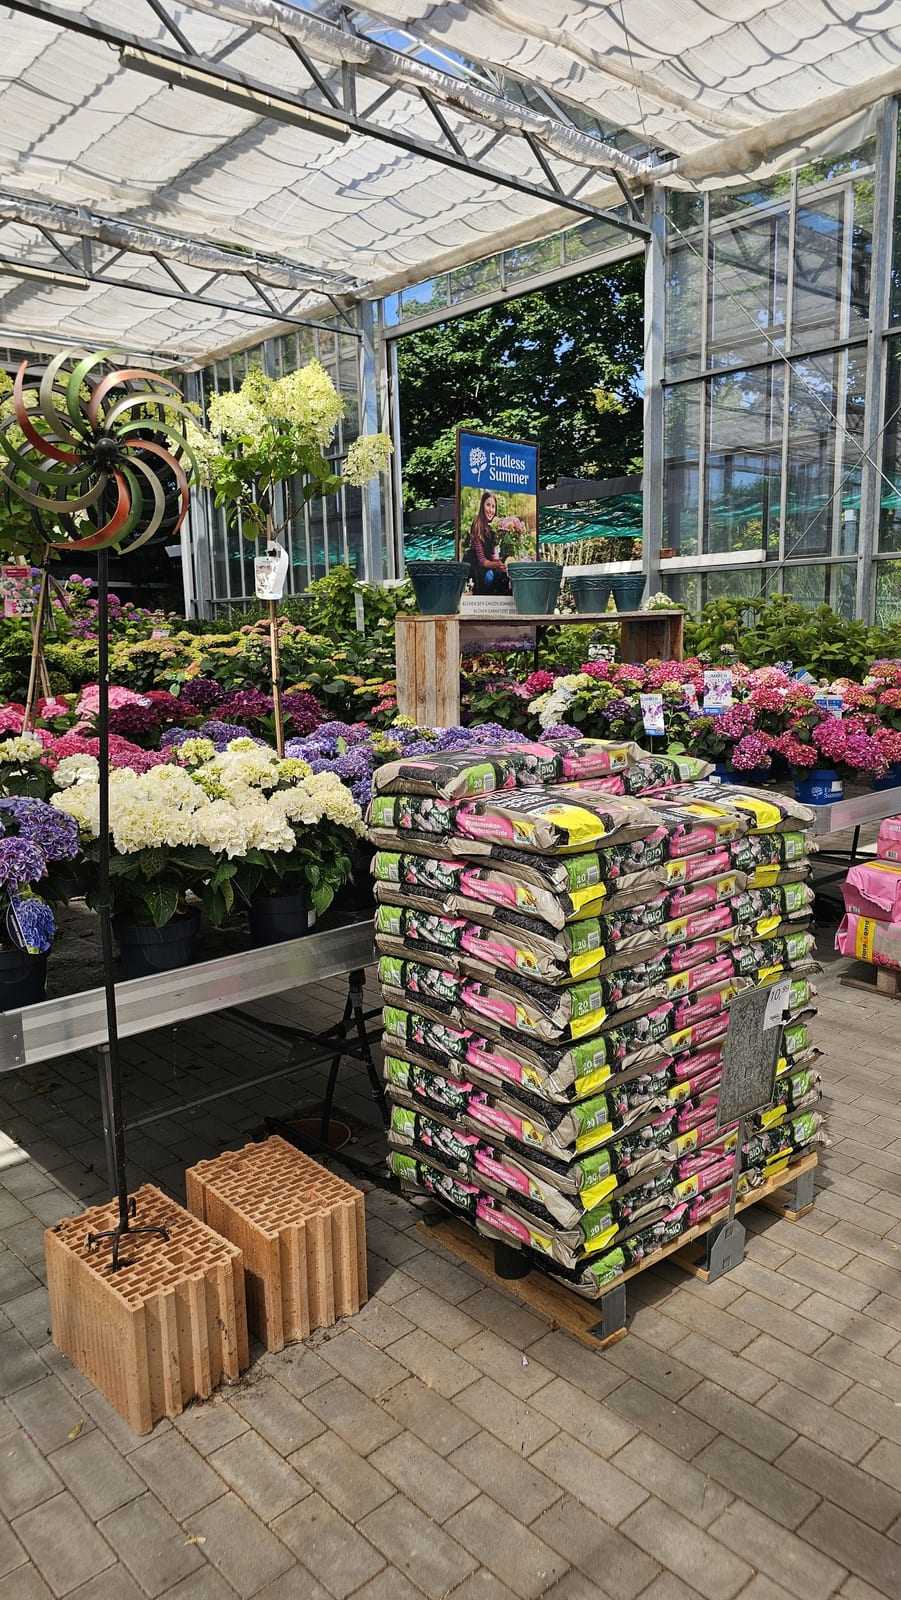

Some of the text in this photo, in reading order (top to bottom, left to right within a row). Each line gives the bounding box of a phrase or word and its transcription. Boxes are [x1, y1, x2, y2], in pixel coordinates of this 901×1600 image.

[489, 452, 526, 471] Endless
[489, 467, 529, 484] Summer
[578, 1000, 589, 1010] 20
